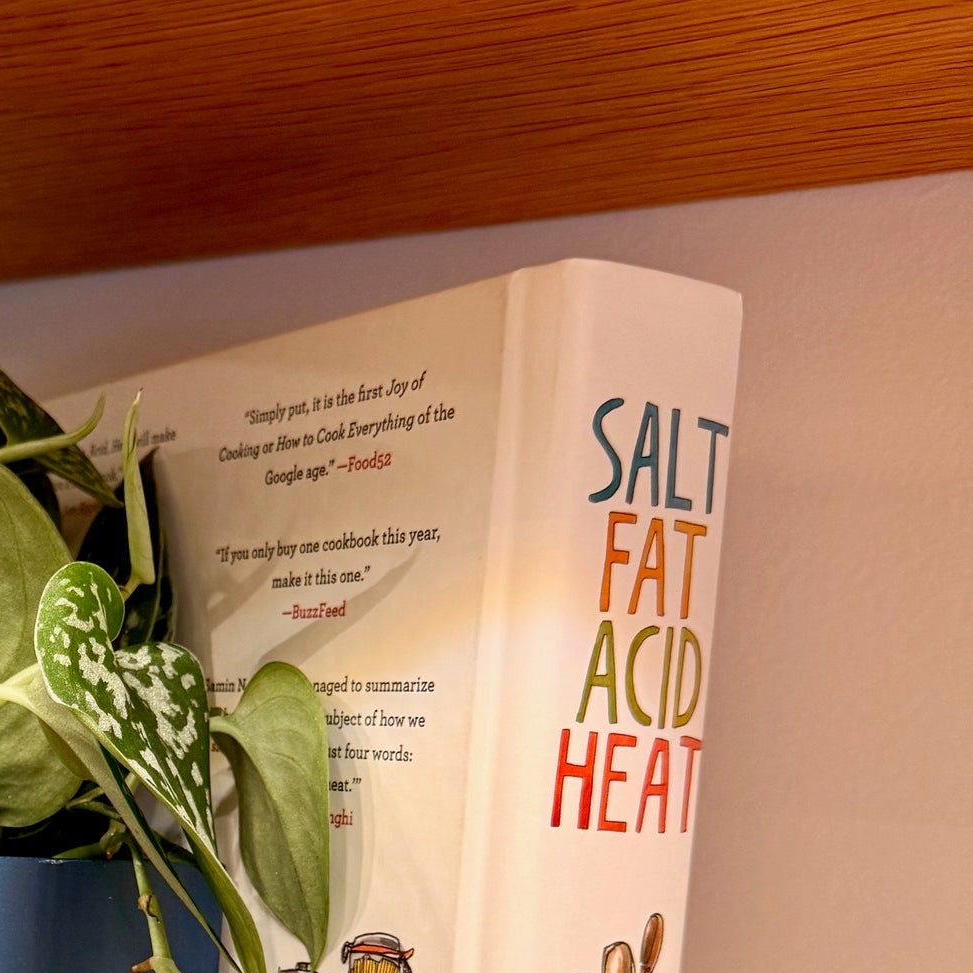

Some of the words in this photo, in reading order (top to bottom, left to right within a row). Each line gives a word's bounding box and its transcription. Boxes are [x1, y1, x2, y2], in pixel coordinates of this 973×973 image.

[245, 403, 286, 425] “Simply
[287, 401, 309, 421] put,
[313, 397, 321, 412] it
[324, 395, 333, 410] is
[336, 389, 355, 406] the
[358, 384, 383, 403] first
[385, 378, 409, 397] Joy
[411, 370, 427, 390] of
[219, 442, 260, 462] Cooking
[262, 442, 274, 454] or
[275, 435, 301, 452] How
[303, 433, 314, 447] to
[317, 422, 345, 444] Cook
[347, 412, 415, 440] Everything
[417, 405, 432, 425] of
[433, 402, 455, 422] the
[588, 397, 729, 514] SALT
[265, 464, 303, 486] Google
[306, 459, 335, 482] age.”
[231, 550, 249, 566] you
[251, 542, 275, 562] only
[277, 540, 298, 560] buy
[299, 540, 320, 555] one
[322, 529, 380, 552] cookbook
[381, 526, 406, 546] this
[408, 527, 441, 548] year,
[599, 511, 707, 619] FAT
[271, 571, 301, 590] make
[303, 570, 313, 586] it
[315, 568, 337, 586] this
[339, 565, 371, 583] one.”
[313, 676, 348, 696] naged
[351, 679, 363, 693] to
[365, 676, 435, 693] summarize
[576, 620, 702, 729] ACID
[325, 708, 362, 730] ubject
[365, 709, 379, 726] of
[379, 710, 406, 728] how
[408, 714, 426, 728] we
[345, 742, 369, 760] four
[373, 744, 413, 762] words:
[550, 728, 702, 834] HEAT
